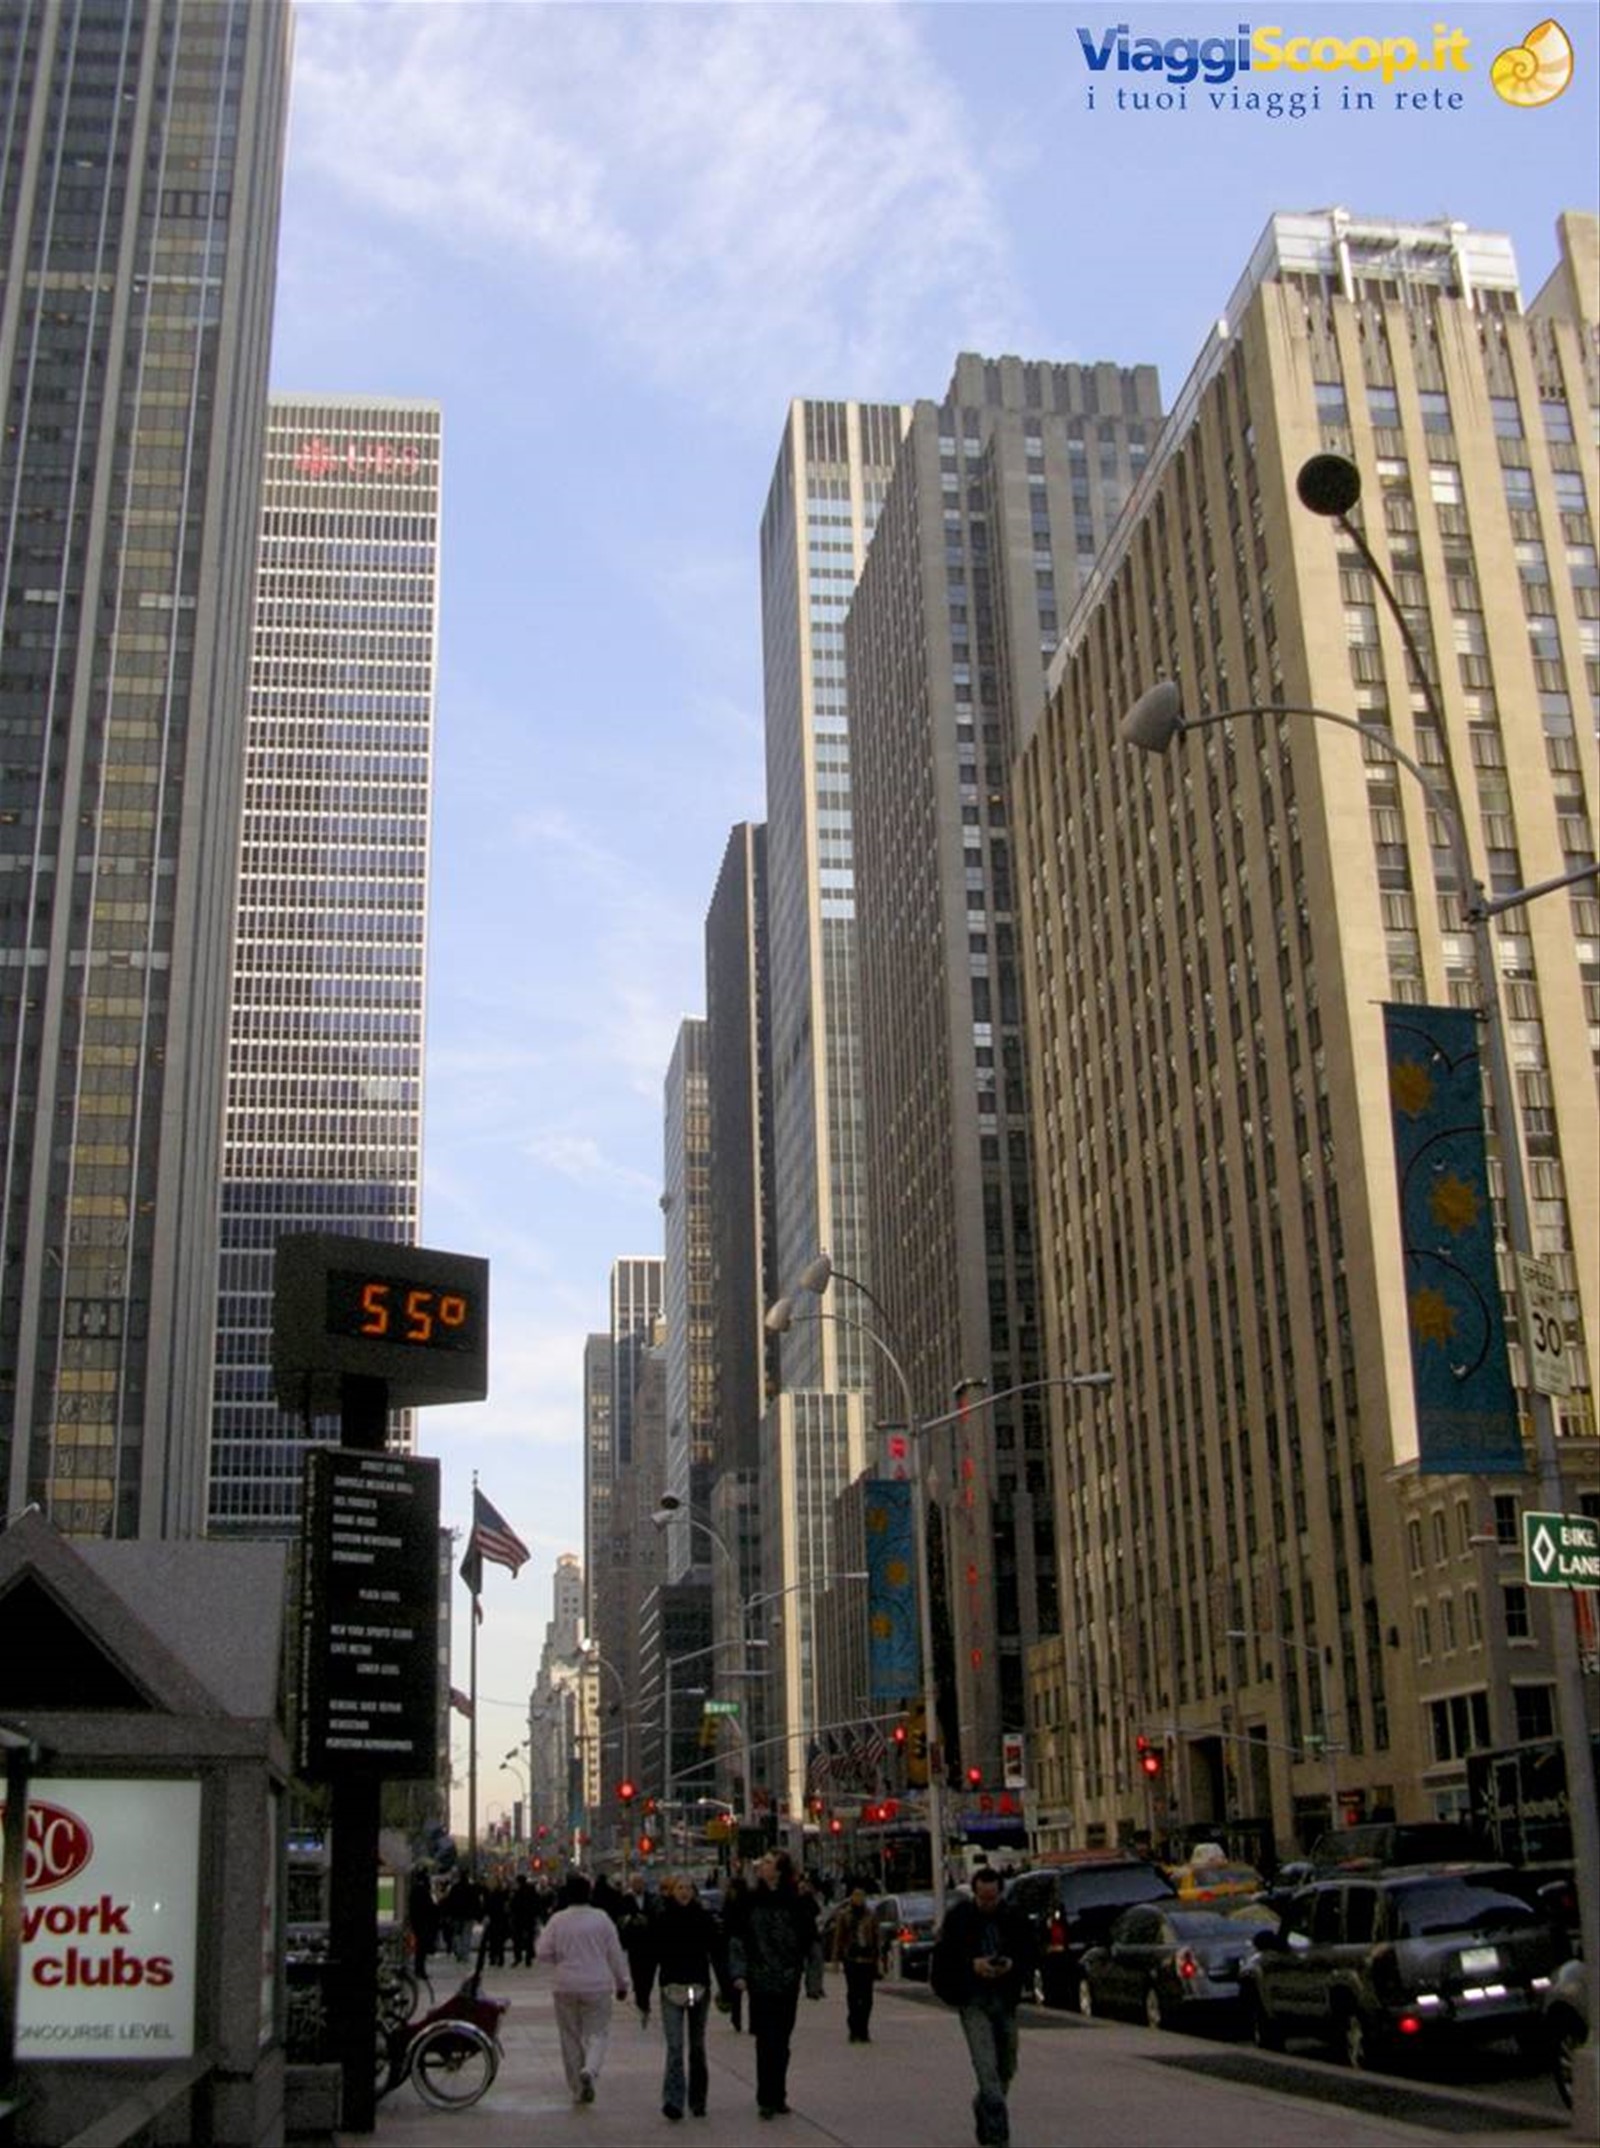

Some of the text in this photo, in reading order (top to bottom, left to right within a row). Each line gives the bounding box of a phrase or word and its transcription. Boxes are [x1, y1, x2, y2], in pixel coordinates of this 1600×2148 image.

[1522, 1264, 1556, 1293] SPEED
[1532, 1312, 1562, 1358] 30
[1560, 1526, 1598, 1549] BIKE
[1558, 1553, 1600, 1577] LANE
[22, 1895, 130, 1943] york
[32, 1948, 174, 1986] clubs
[119, 2023, 173, 2039] LEVEL
